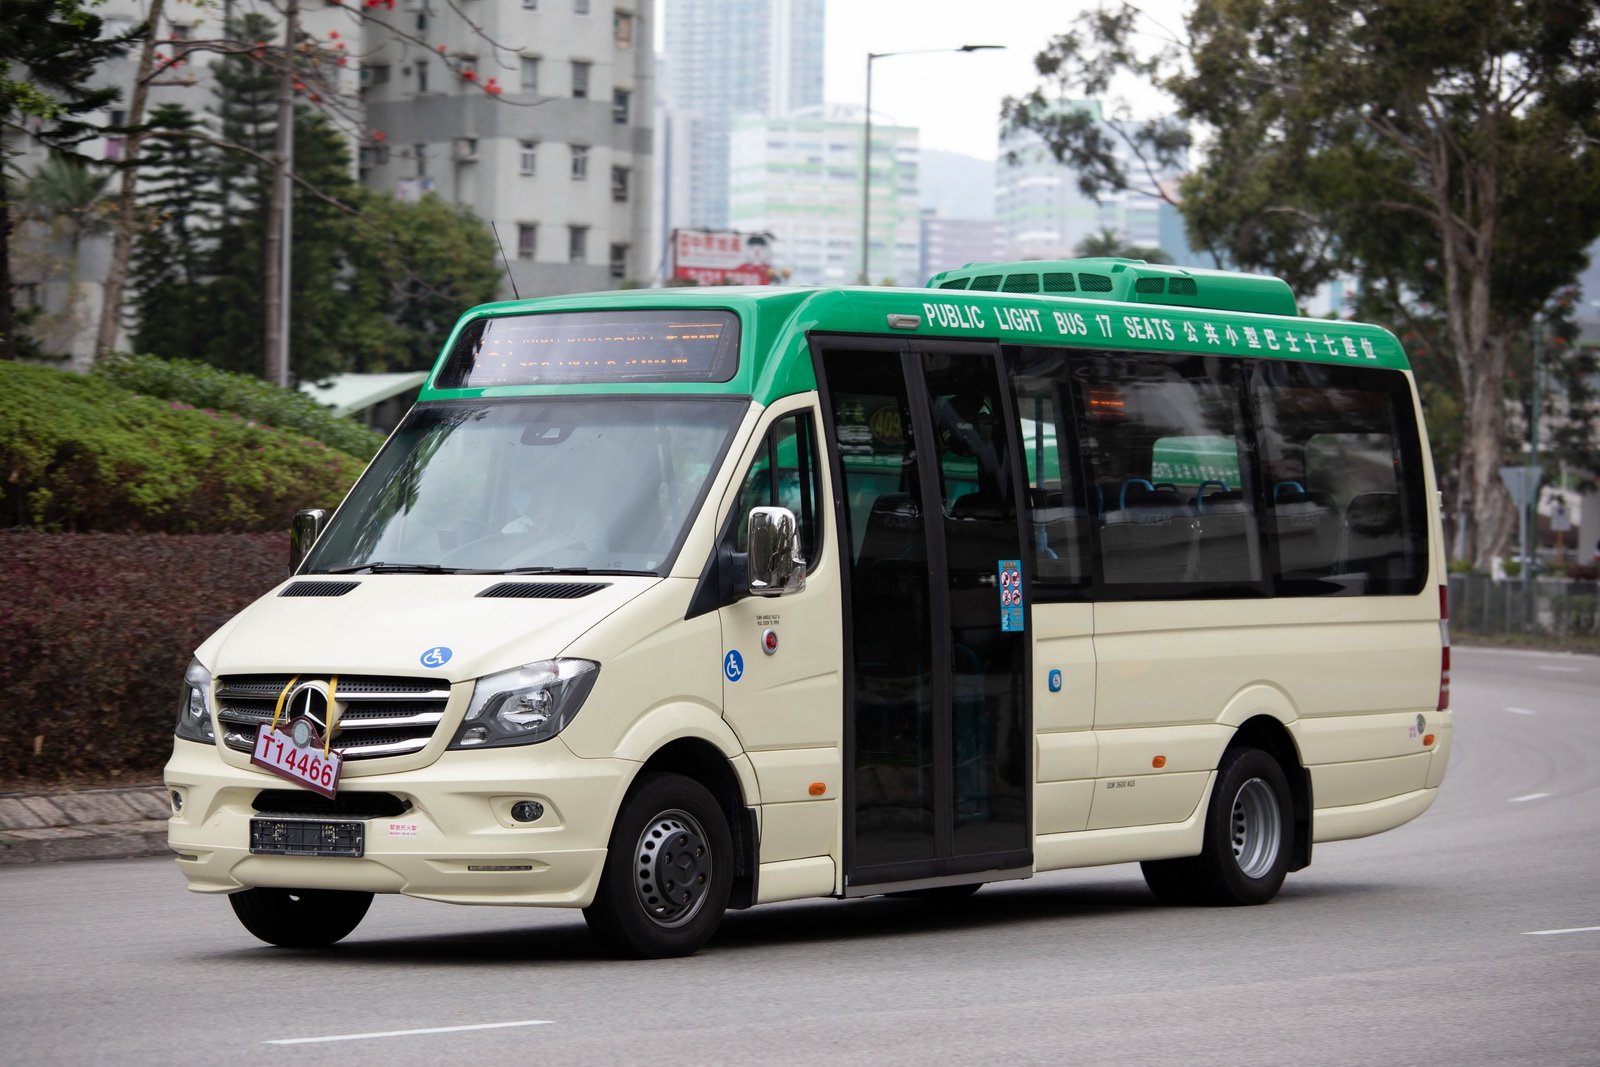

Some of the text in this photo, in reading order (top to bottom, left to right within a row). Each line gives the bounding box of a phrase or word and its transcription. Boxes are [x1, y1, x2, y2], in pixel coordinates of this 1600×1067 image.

[922, 302, 1176, 341] PUBLIC LIGHT BUS 17 SEATS
[1182, 320, 1378, 360] 公共小型巴士十七座位
[262, 734, 333, 787] T14466
